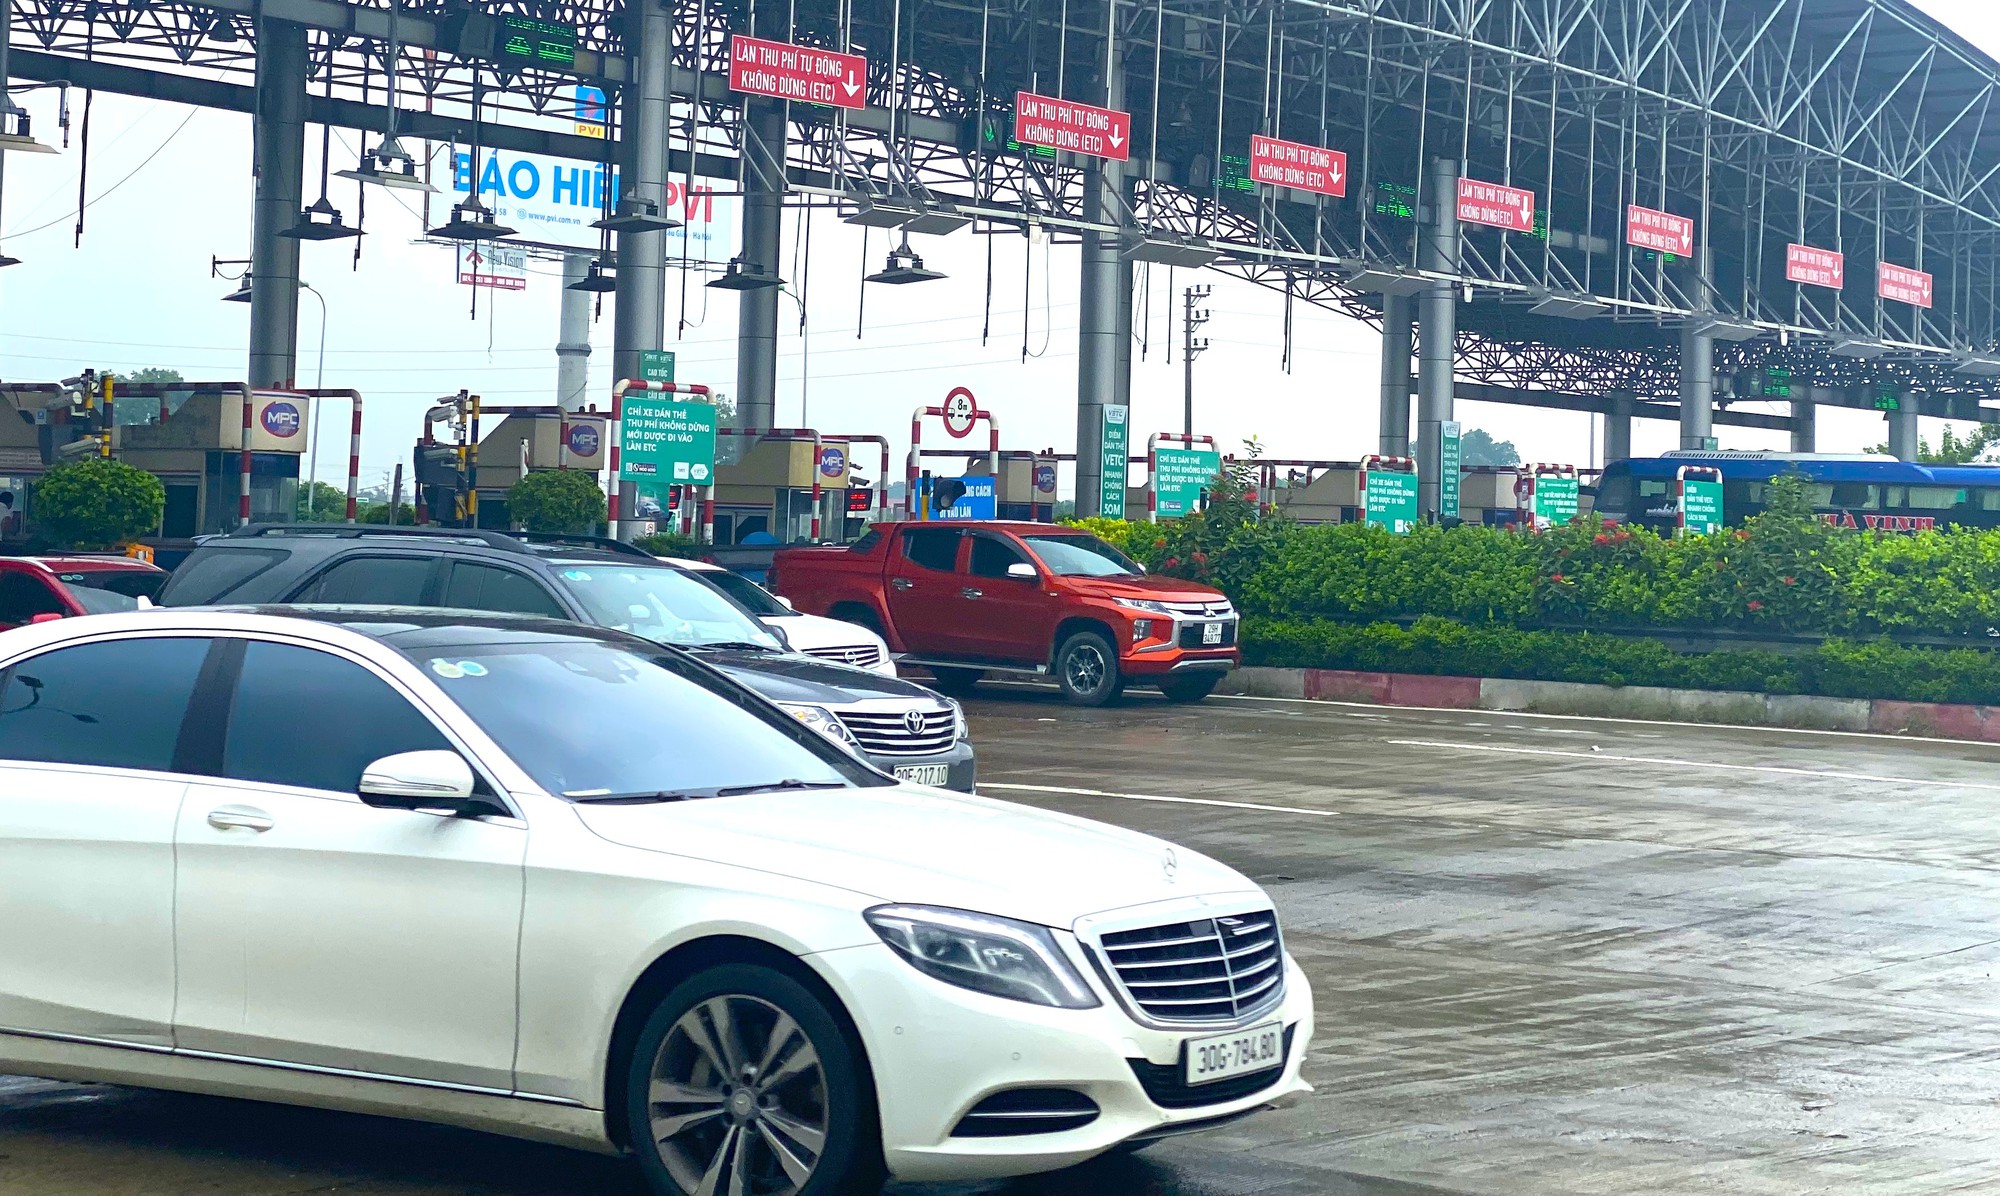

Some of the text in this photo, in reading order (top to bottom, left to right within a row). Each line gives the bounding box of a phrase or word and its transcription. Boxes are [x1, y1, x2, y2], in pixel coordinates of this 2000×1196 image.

[737, 40, 842, 78] LÀN THU PHÍ TỰ ĐỘNG
[742, 70, 835, 101] KHÔNG DỪNG (ETC)
[1021, 97, 1108, 132] LÀN THU PHÍ TỰ ĐỘNG
[579, 125, 600, 136] PVI
[1025, 123, 1054, 143] KHÔNG
[1056, 127, 1079, 148] DỪNG
[1082, 135, 1102, 152] (ETC)
[1255, 139, 1329, 169] LÀN THU PHÍ TỰ ĐỘNG
[1259, 162, 1282, 181] KHÔNG
[1285, 166, 1304, 184] DỪNG
[1306, 172, 1324, 188] (ETC)
[1461, 182, 1520, 208] LÀN THU PHÍ TỰ ĐỘNG
[528, 213, 580, 225] www.pvi.com.vn
[1460, 203, 1513, 226] KHÔNG DỪNG (ETC)
[268, 412, 297, 424] MPC
[628, 405, 641, 416] CHỈ
[655, 408, 670, 418] DÁN
[673, 409, 687, 419] THẺ
[627, 419, 709, 432] THU PHÍ KHÔNG DỪNG
[572, 434, 597, 445] MPC
[627, 429, 642, 439] MỚI
[644, 432, 666, 442] ĐƯỢC
[678, 432, 692, 442] VÀO
[626, 440, 656, 451] LÀN ETC
[1105, 441, 1115, 449] DÁN
[821, 456, 843, 467] MPC
[1105, 454, 1123, 466] VETC
[1105, 471, 1123, 479] NHANH
[976, 483, 991, 497] CÁCH
[1104, 481, 1122, 489] CHÓNG
[1106, 491, 1119, 500] CÁCH
[960, 503, 971, 517] LÀN
[1104, 504, 1120, 515] 50M
[1862, 514, 1935, 531] VINH
[1198, 1032, 1276, 1074] 30G-784.80
